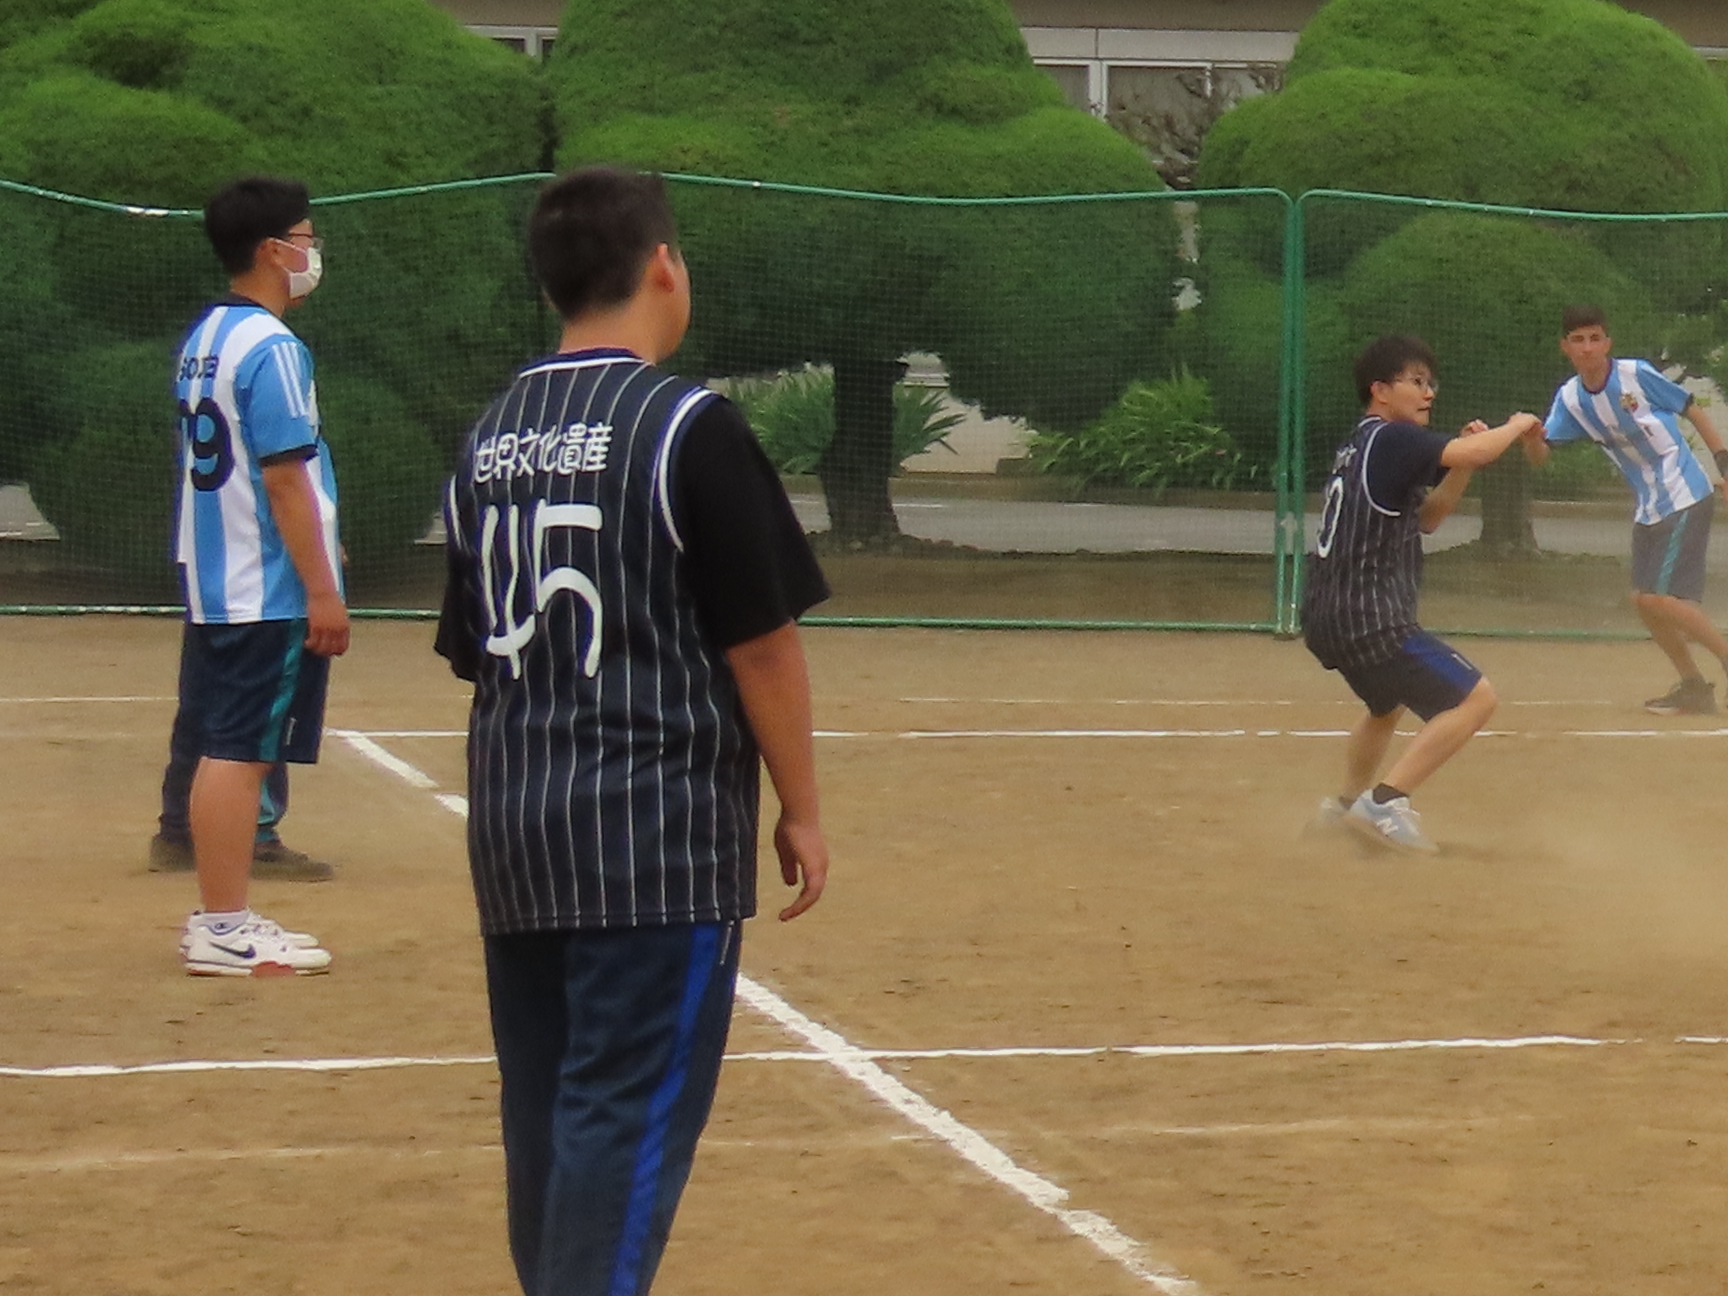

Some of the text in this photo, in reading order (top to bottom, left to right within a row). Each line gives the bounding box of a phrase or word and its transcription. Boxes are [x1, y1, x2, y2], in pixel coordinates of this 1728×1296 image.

[475, 422, 613, 484] 世界文化遺産
[481, 498, 603, 680] 45
